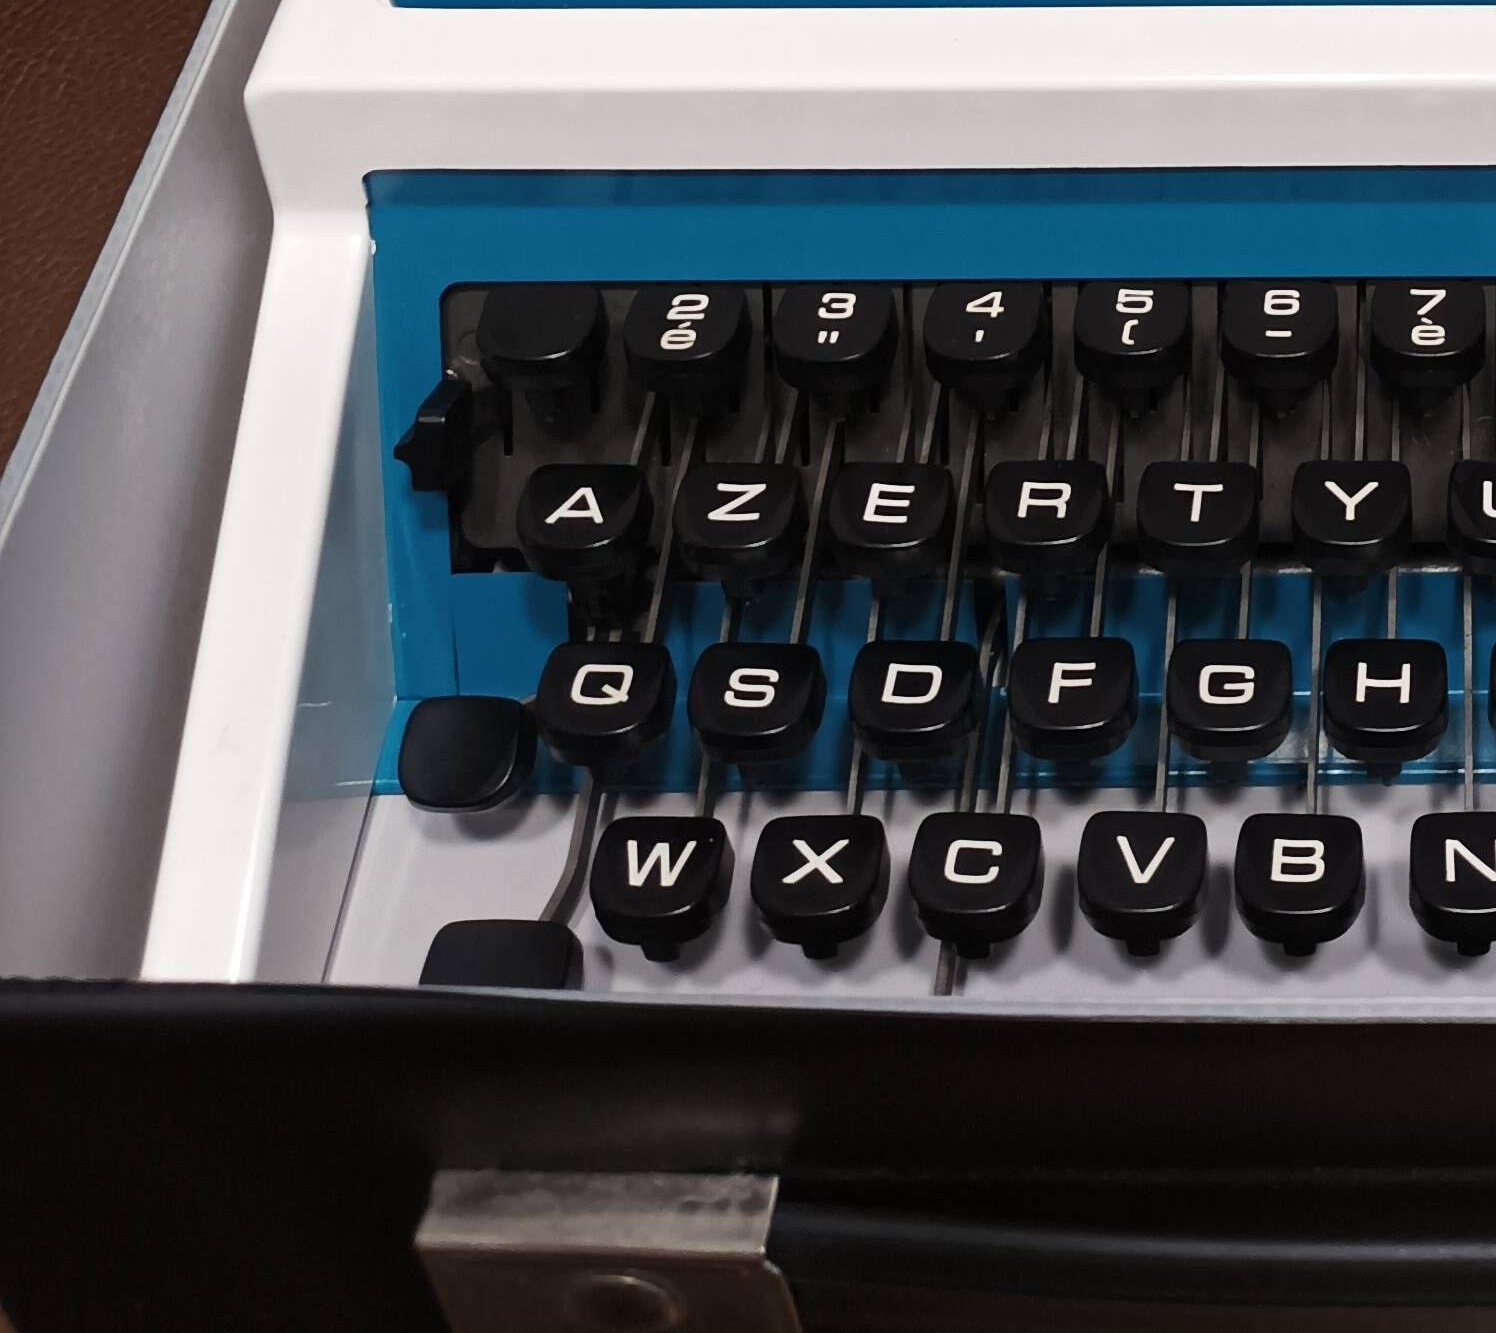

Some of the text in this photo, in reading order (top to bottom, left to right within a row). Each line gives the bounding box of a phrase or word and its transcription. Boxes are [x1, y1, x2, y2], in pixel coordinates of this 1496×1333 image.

[666, 293, 710, 320] 2
[817, 292, 857, 319] 3
[965, 291, 1005, 318] 4
[1115, 288, 1154, 314] 5
[1263, 289, 1300, 316] 6
[1409, 288, 1447, 316] 7
[660, 321, 697, 350] é
[1411, 317, 1446, 346] è
[545, 487, 604, 524] A
[707, 482, 767, 522] Z
[862, 482, 915, 524] E
[1017, 481, 1072, 519] R
[1173, 482, 1224, 522] T
[1324, 480, 1379, 521] Y
[570, 663, 634, 705] Q
[724, 667, 780, 708] S
[881, 662, 943, 704] D
[1047, 662, 1097, 704] F
[1199, 664, 1255, 705] G
[1355, 661, 1411, 704] H
[627, 839, 697, 887] W
[782, 839, 850, 884] X
[944, 839, 1003, 884] C
[1116, 835, 1175, 884] V
[1270, 838, 1325, 883] B
